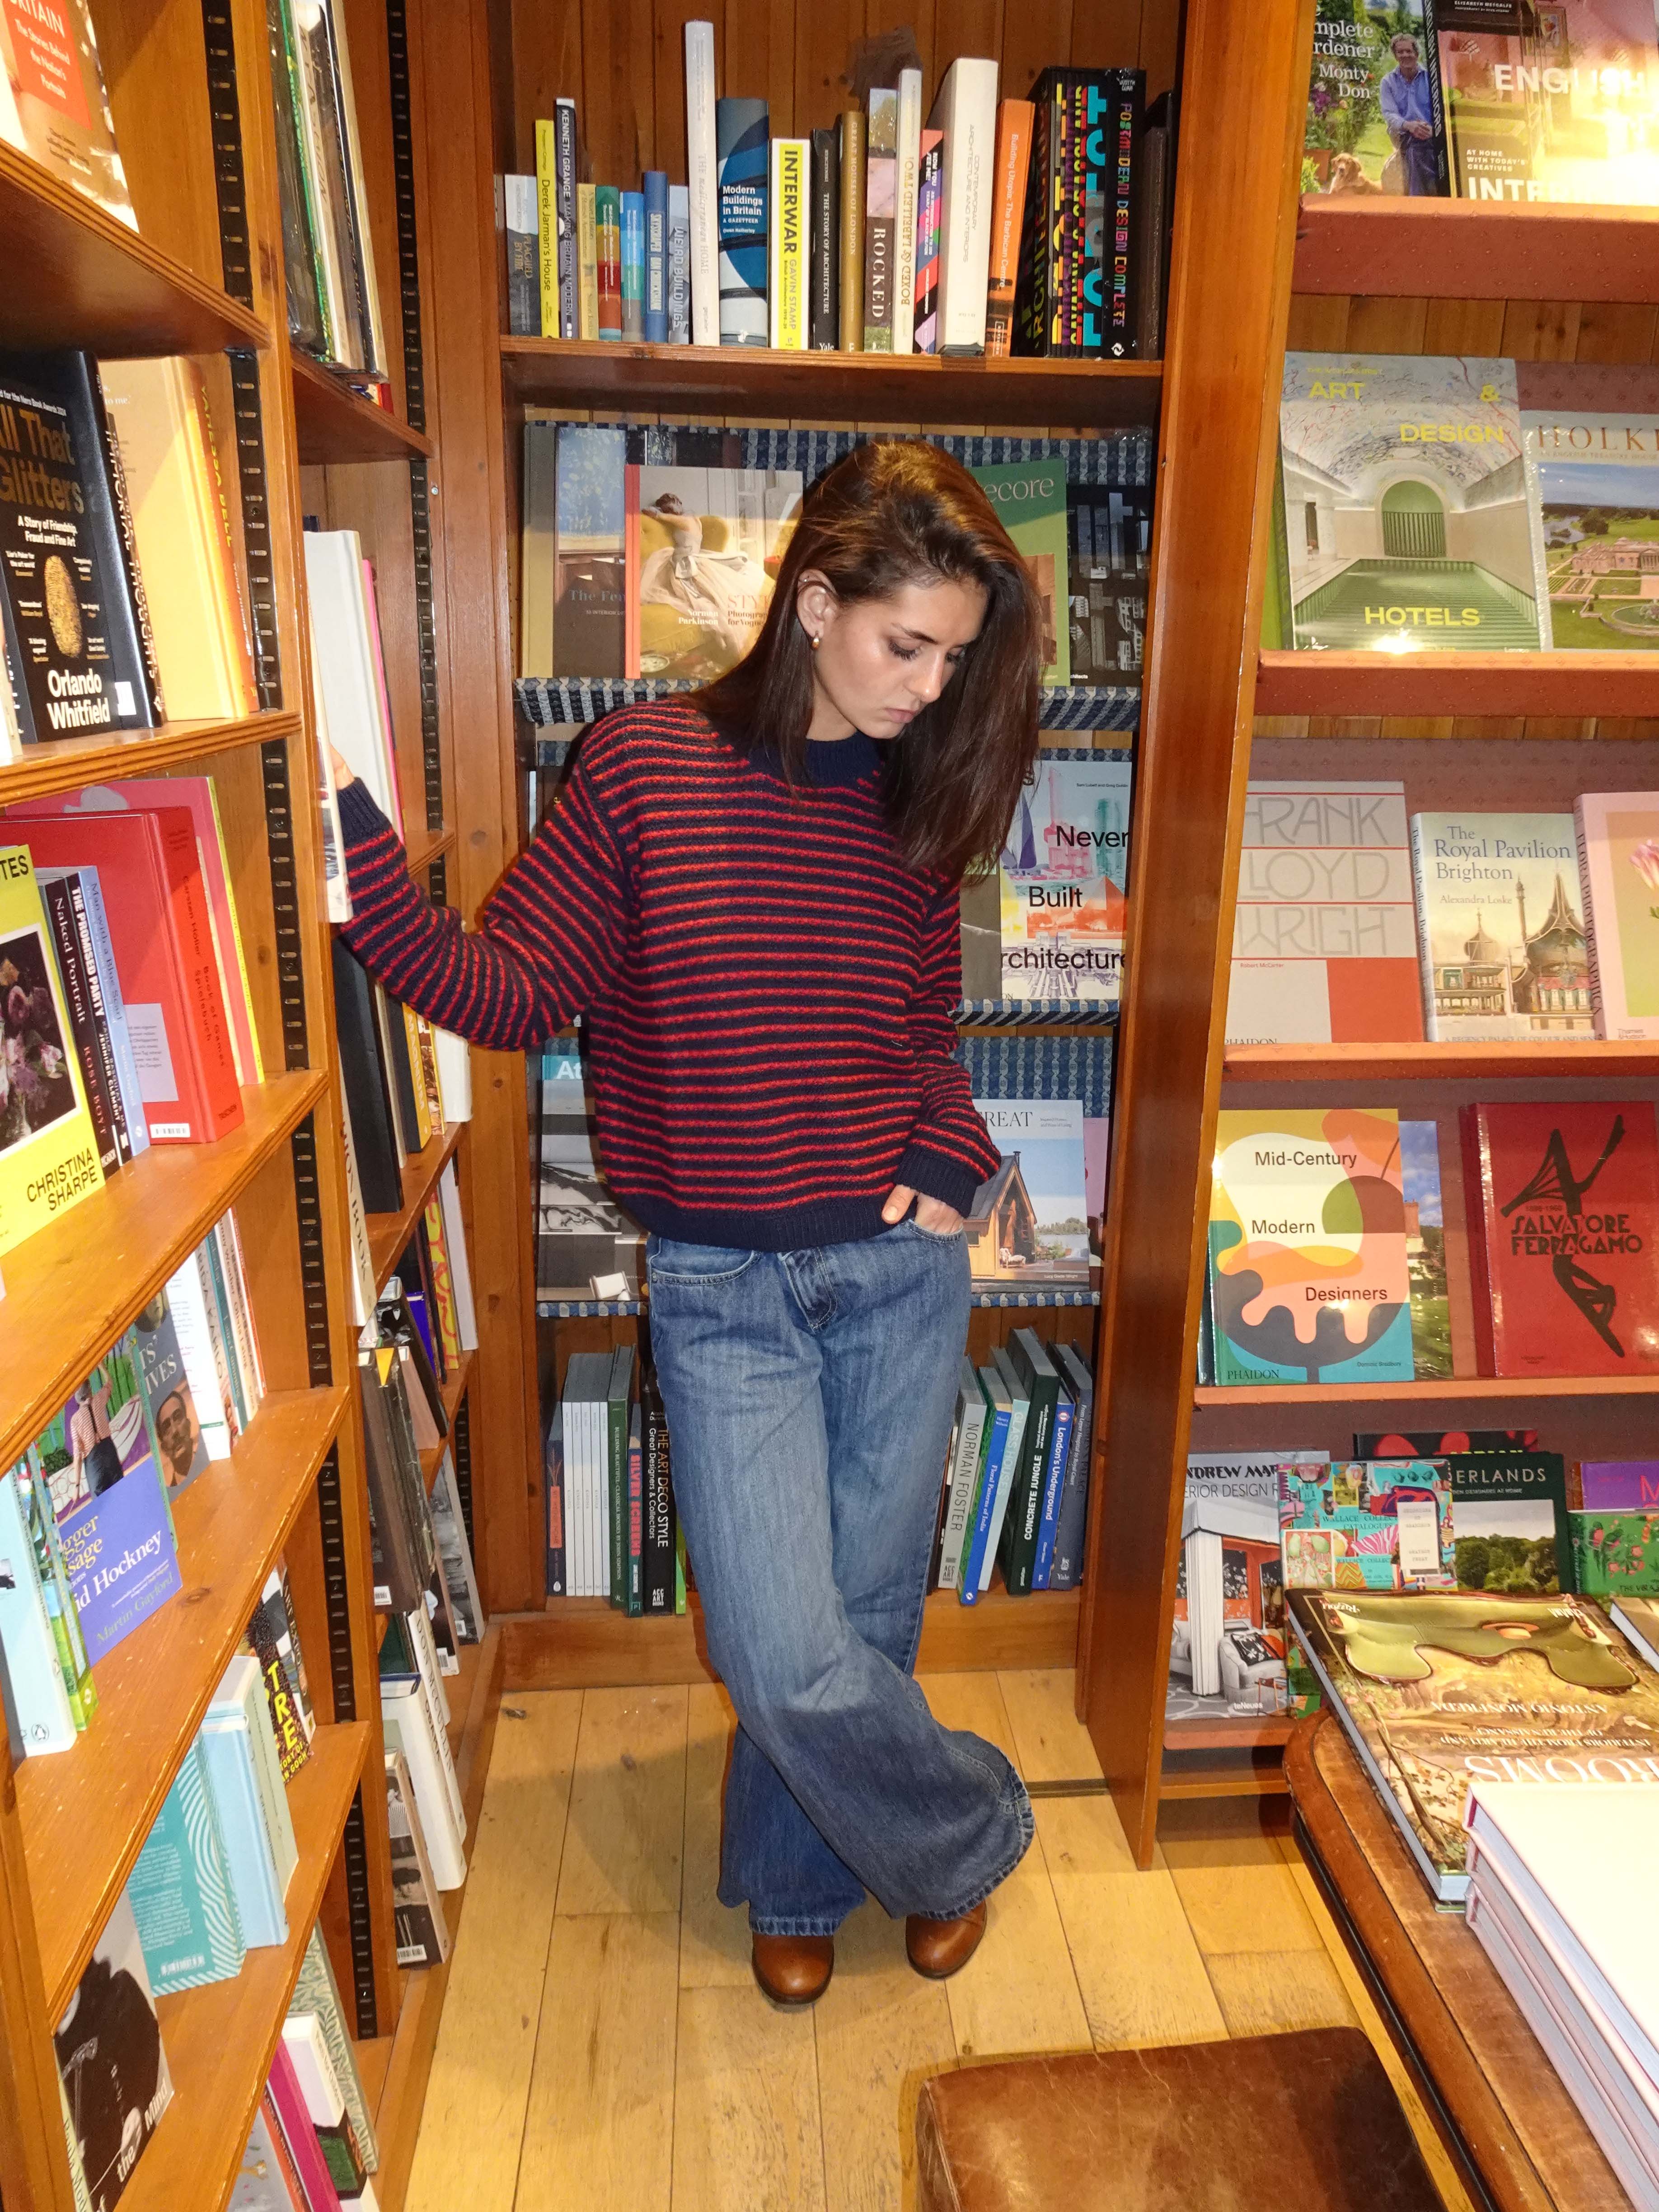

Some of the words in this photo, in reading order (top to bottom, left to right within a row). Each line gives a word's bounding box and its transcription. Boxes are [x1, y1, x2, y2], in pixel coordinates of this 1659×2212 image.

[1319, 63, 1369, 83] Monty
[1338, 83, 1371, 99] Don
[1430, 59, 1442, 137] INTERIORS
[562, 108, 570, 157] KENNETH
[698, 155, 706, 175] THE
[1007, 133, 1019, 168] Building
[1467, 164, 1513, 172] CREATIVES
[542, 179, 550, 209] Derek
[723, 185, 755, 195] Modern
[1005, 169, 1016, 202] Utopia:
[723, 196, 763, 206] Buildings
[723, 206, 731, 215] in
[733, 206, 762, 216] Britain
[784, 150, 798, 254] INTERWAR
[1004, 202, 1013, 219] The
[543, 209, 551, 258] Jarman's
[564, 201, 572, 240] MAKING
[902, 192, 913, 249] LABELLED
[1115, 200, 1129, 253] DESIGN
[824, 240, 830, 249] OF
[1002, 220, 1012, 259] Barbican
[701, 245, 709, 276] HOME
[901, 251, 912, 264] &
[872, 228, 886, 318] ROCKED
[901, 266, 911, 305] BOXED
[999, 259, 1009, 288] Centre
[673, 265, 684, 331] BUILDINGS
[1113, 256, 1127, 328] COMPLETE
[788, 296, 797, 330] STAMP
[819, 342, 834, 352] Yale
[1308, 381, 1365, 400] ART
[1480, 384, 1500, 402] &
[19, 408, 75, 466] That
[1400, 423, 1504, 443] DESIGN
[202, 385, 222, 487] VANESSA
[220, 494, 232, 548] BELL
[0, 455, 84, 514] Glitters
[18, 515, 24, 527] A
[24, 516, 42, 532] Story
[42, 519, 50, 530] of
[50, 520, 78, 535] Friendship,
[24, 530, 44, 544] Fraud
[44, 533, 54, 545] and
[54, 534, 65, 546] Fine
[65, 535, 76, 548] Art
[105, 430, 131, 551] IMMORTAL
[129, 562, 156, 680] THOUGHTS
[678, 617, 719, 626] Parkinson
[688, 609, 719, 618] Norman
[1364, 606, 1481, 626] HOTELS
[47, 668, 102, 698] Orlando
[47, 698, 111, 730] Whitfield
[1056, 825, 1129, 848] Never
[1447, 825, 1476, 840] The
[1413, 847, 1422, 874] Royal
[1434, 839, 1488, 862] Royal
[1496, 839, 1572, 859] Pavilion
[1576, 834, 1589, 883] FLORA
[1436, 861, 1513, 883] Brighton
[71, 886, 84, 912] THE
[1029, 886, 1083, 908] Built
[1440, 894, 1485, 904] Alexandra
[1487, 894, 1513, 904] Loske
[76, 912, 97, 976] PROMISED
[1237, 906, 1395, 956] WRIGHT
[55, 897, 74, 953] Naked
[66, 957, 86, 1024] Portrait
[90, 882, 99, 911] Man
[98, 915, 108, 944] with
[107, 958, 115, 986] Blue
[112, 990, 122, 1021] Scarf
[182, 875, 194, 919] Carsten
[203, 965, 215, 998] Book
[210, 1005, 217, 1019] of
[215, 1023, 227, 1068] Games
[88, 975, 105, 1017] PARTY
[83, 1046, 97, 1088] ROSE
[94, 1095, 107, 1134] BOYT
[98, 1033, 112, 1077] JENNIFER
[108, 1079, 121, 1121] CLEMENT
[1254, 1150, 1358, 1169] Mid-Century
[27, 1147, 94, 1203] CHRISTINA
[48, 1165, 98, 1211] SHARPE
[1251, 1218, 1316, 1235] Modern
[1510, 1214, 1631, 1235] SALVATORE
[1511, 1234, 1643, 1256] FERRAGAMO
[1305, 1285, 1388, 1302] Designers
[1227, 1369, 1279, 1380] PHAIDON
[658, 1429, 669, 1449] THE
[959, 1422, 979, 1477] NORMAN
[1053, 1427, 1067, 1466] London's
[648, 1451, 656, 1490] Designers
[657, 1451, 669, 1474] ART
[989, 1465, 998, 1483] Floral
[657, 1477, 669, 1514] DECO
[984, 1483, 994, 1507] Patterns
[1024, 1490, 1037, 1541] CONCRETE
[1031, 1454, 1042, 1490] JUNGLE
[1045, 1466, 1061, 1521] Underground
[1226, 1482, 1267, 1499] DESIGN
[951, 1482, 970, 1532] FOSTER
[1322, 1514, 1359, 1523] WALLACE
[657, 1516, 669, 1548] STYLE
[979, 1516, 989, 1532] India
[93, 1530, 161, 1596] Hockney
[96, 1609, 133, 1642] Martin
[135, 1572, 174, 1611] Gayford
[1234, 1701, 1264, 1710] teNeues
[1430, 1701, 1527, 1714] MONFREDA
[1531, 1703, 1607, 1714] ANTONIO
[295, 1741, 304, 1754] OF
[1546, 1738, 1584, 1747] FROM
[1584, 1738, 1651, 1748] INTERIORS
[290, 1751, 308, 1774] GOGH
[144, 2077, 167, 2132] Mind
[117, 2150, 136, 2183] the
